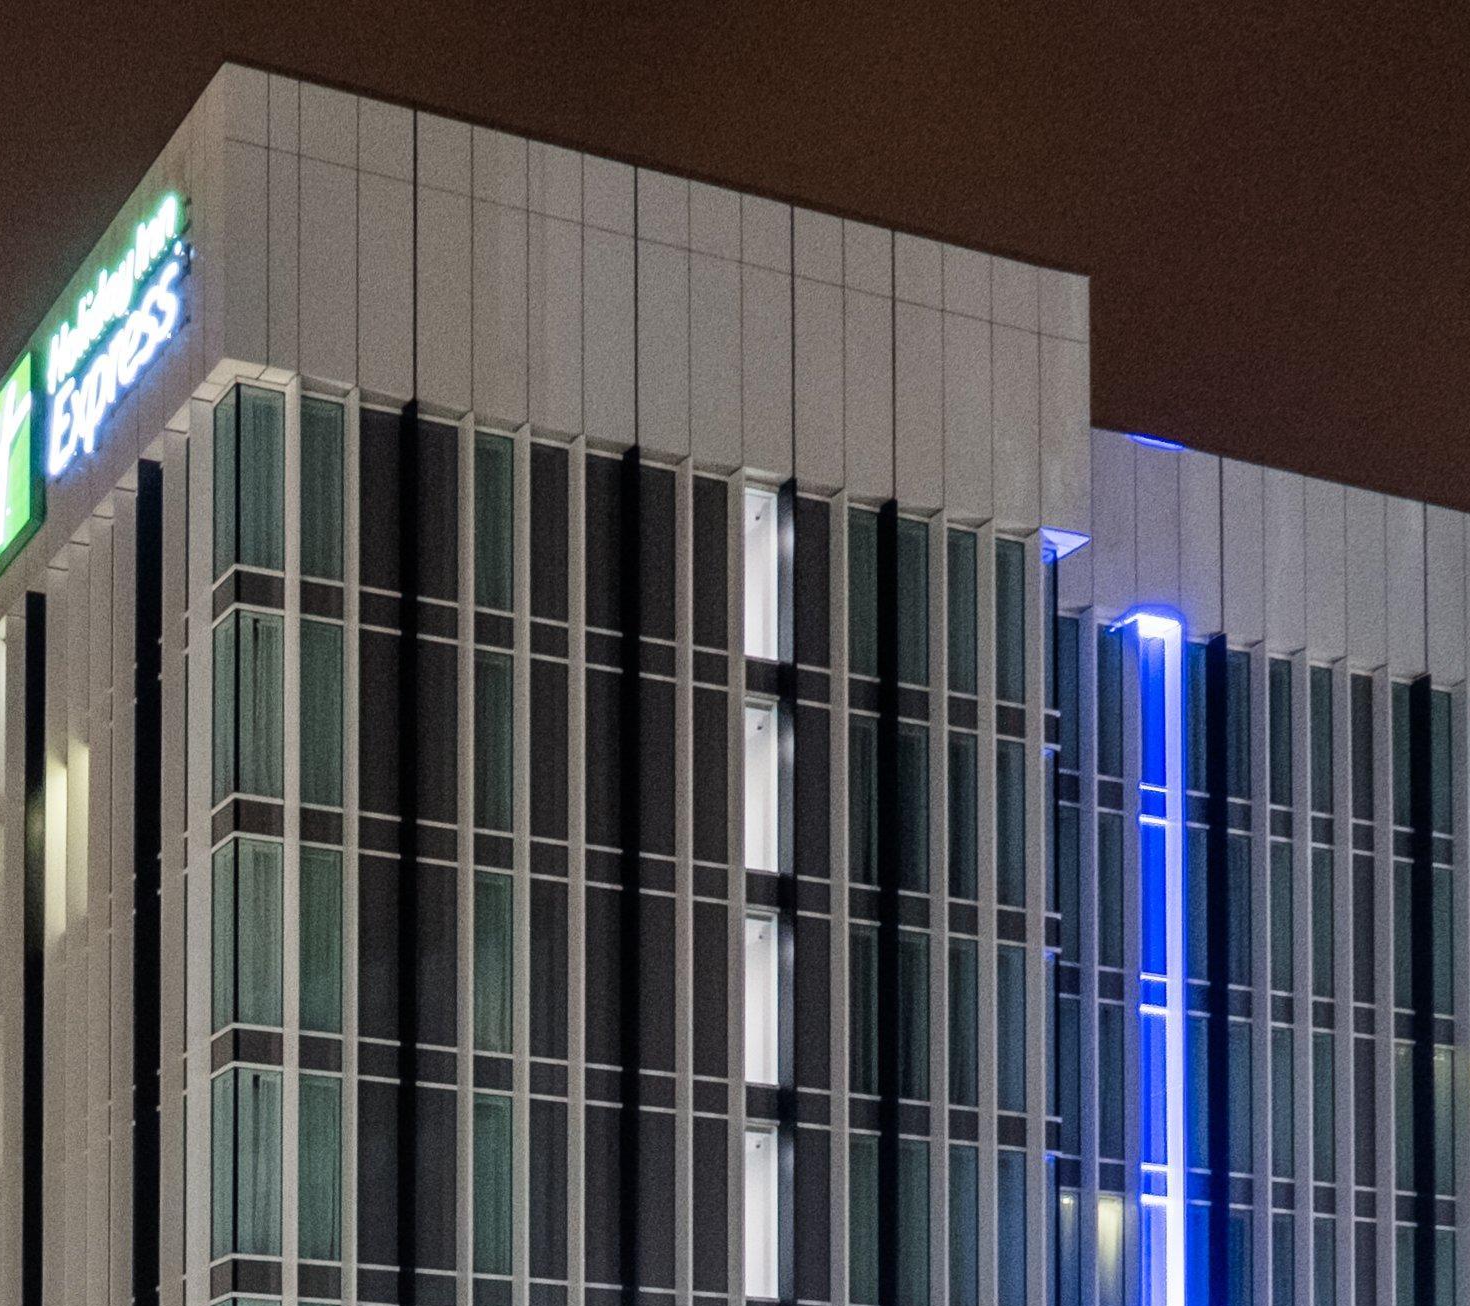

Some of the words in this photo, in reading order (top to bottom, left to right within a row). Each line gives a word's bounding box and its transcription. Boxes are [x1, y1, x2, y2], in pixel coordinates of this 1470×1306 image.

[46, 249, 133, 393] Holiday
[134, 194, 177, 279] Inn
[48, 262, 181, 476] Express
